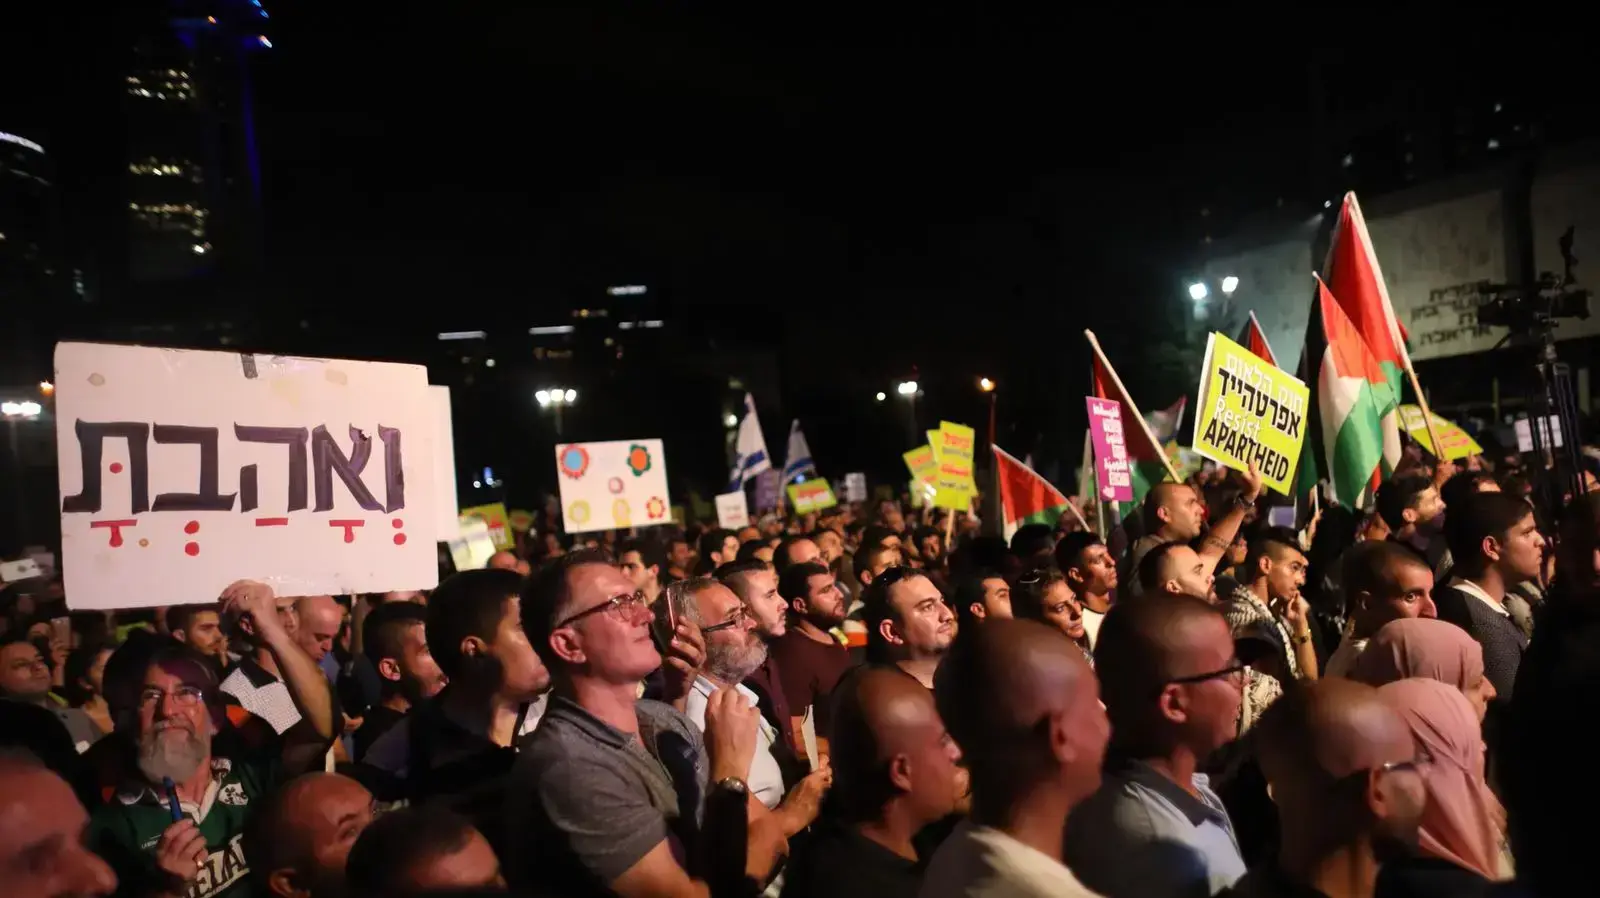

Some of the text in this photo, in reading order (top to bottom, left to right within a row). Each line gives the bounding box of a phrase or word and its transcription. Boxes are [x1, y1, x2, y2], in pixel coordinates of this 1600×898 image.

[1214, 396, 1261, 439] Resist
[1218, 368, 1301, 438] אפרטהייד
[1203, 418, 1290, 482] APARTHEID
